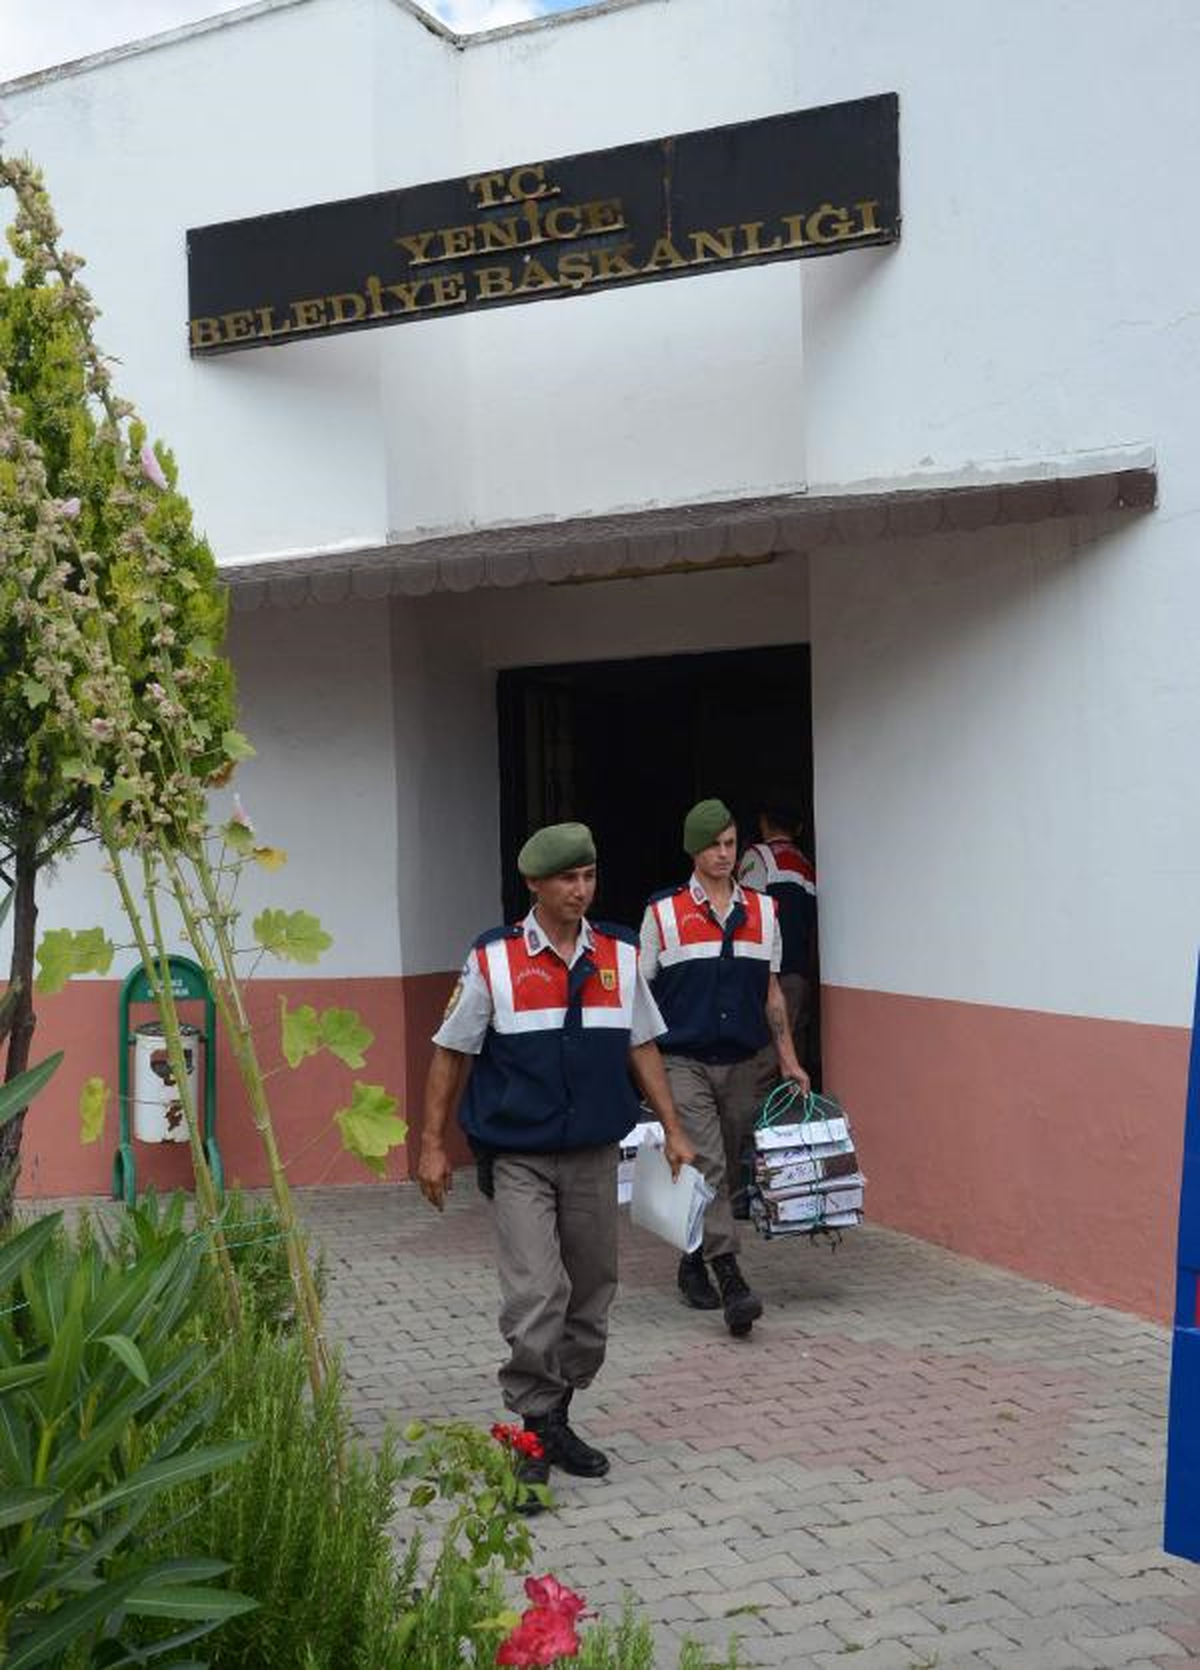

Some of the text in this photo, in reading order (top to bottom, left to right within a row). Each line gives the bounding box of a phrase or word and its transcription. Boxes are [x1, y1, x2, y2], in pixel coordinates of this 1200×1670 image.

[190, 200, 881, 349] BELEDİYE BAŞKANLIĞI
[395, 196, 625, 265] YENİCE
